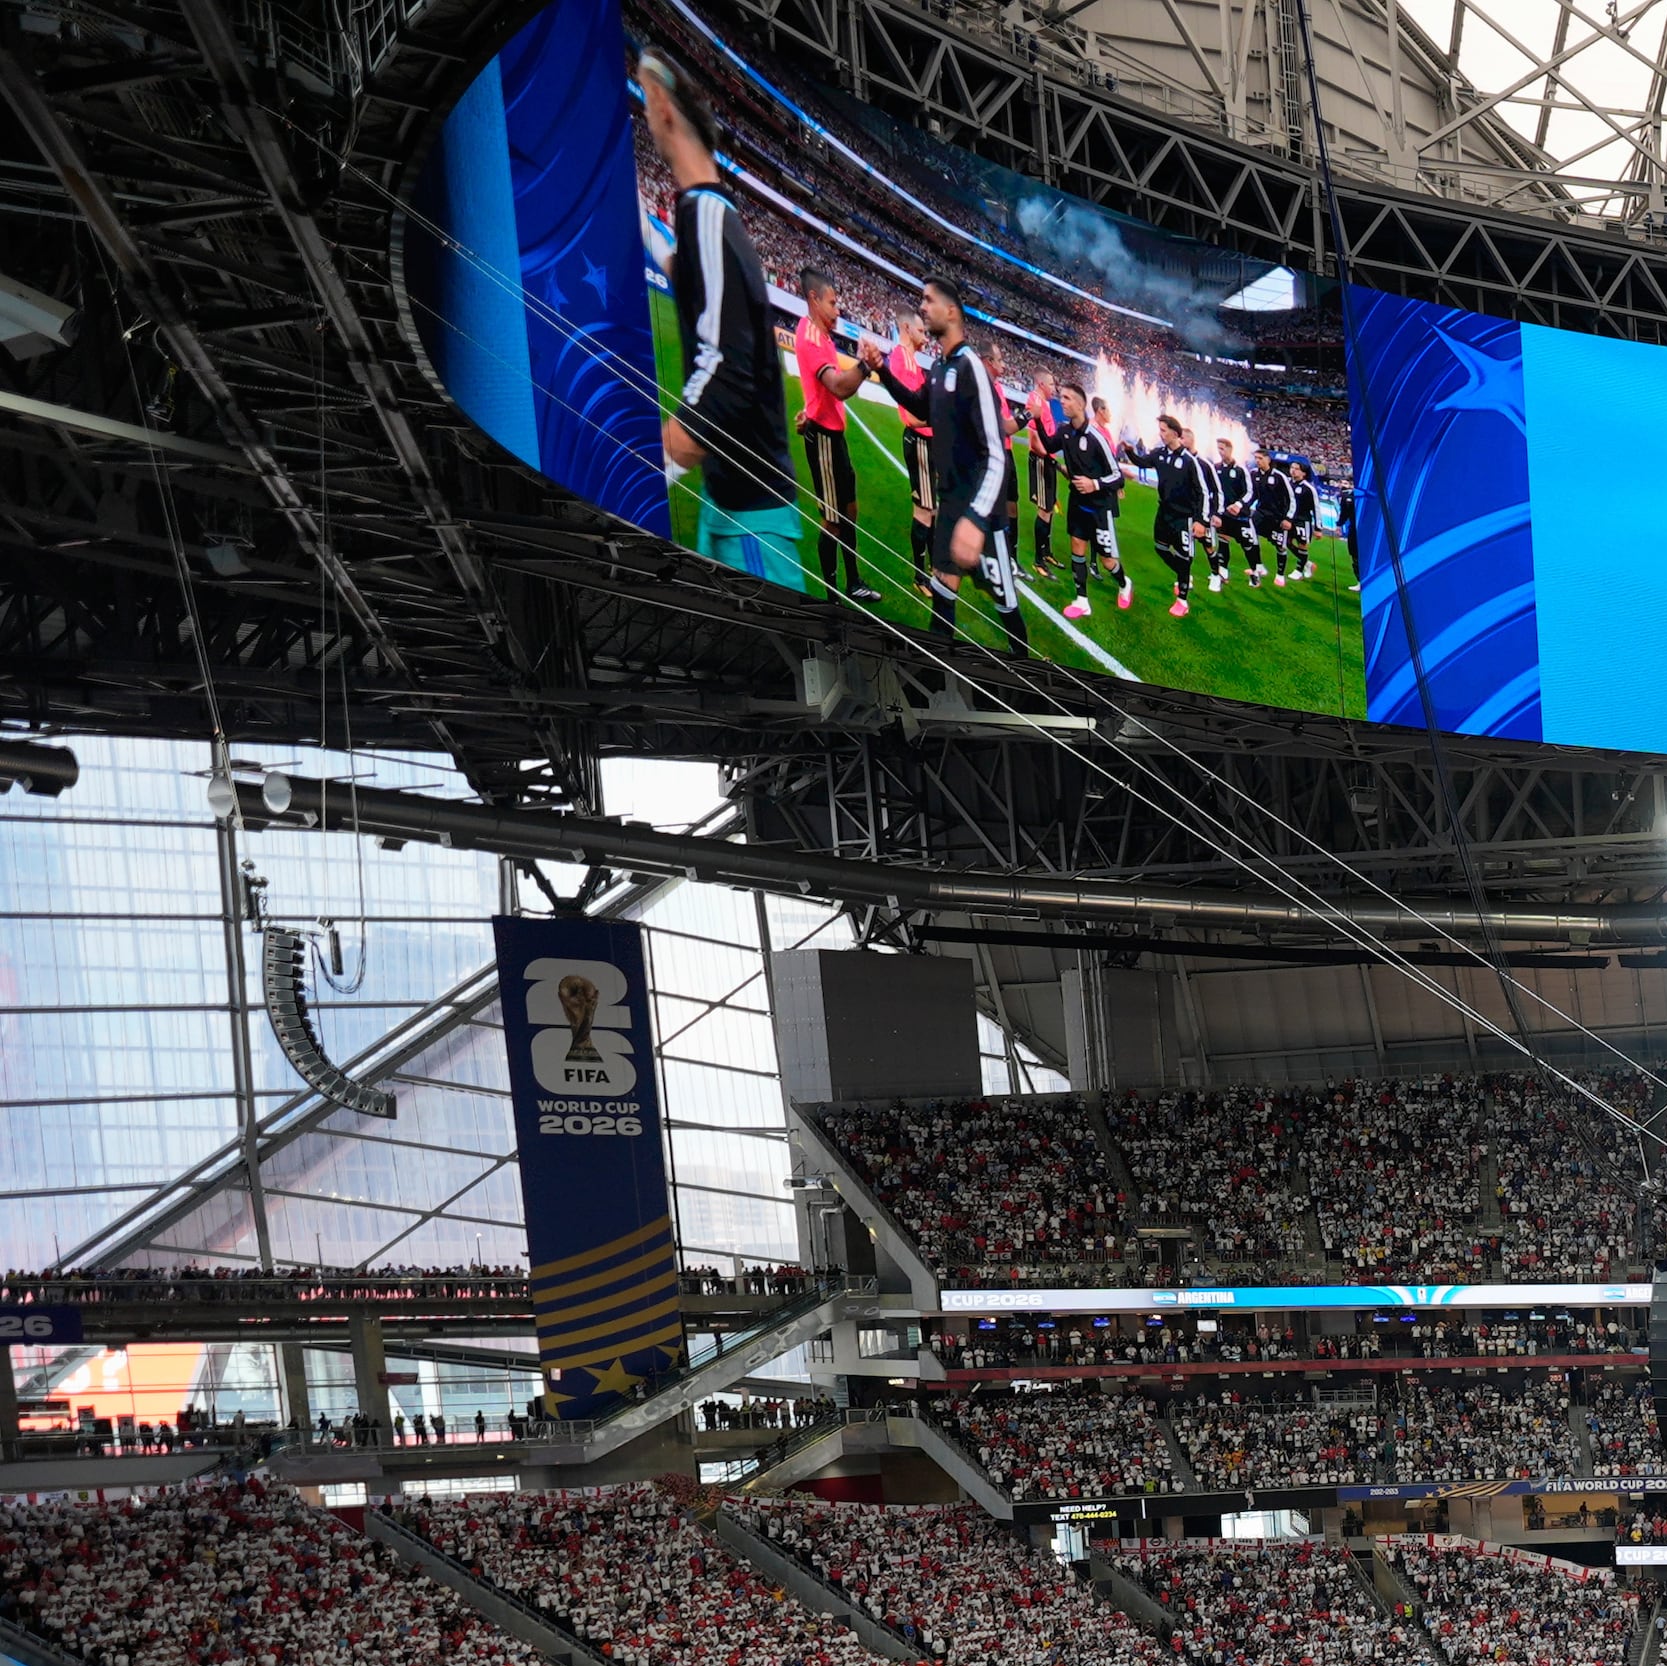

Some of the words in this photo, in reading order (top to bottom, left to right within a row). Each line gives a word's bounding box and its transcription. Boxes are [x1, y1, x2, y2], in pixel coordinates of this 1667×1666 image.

[564, 1069, 611, 1084] FIFA
[537, 1100, 602, 1113] WORLD
[605, 1102, 640, 1114] CUP
[539, 1115, 643, 1136] 2026
[951, 1294, 985, 1306] CUP
[988, 1294, 1043, 1306] 2026
[1176, 1292, 1235, 1305] ARGENTINA
[1546, 1481, 1572, 1491] FIFA
[1573, 1480, 1618, 1491] WORLD
[1620, 1480, 1644, 1490] CUP
[1624, 1551, 1650, 1561] CUP
